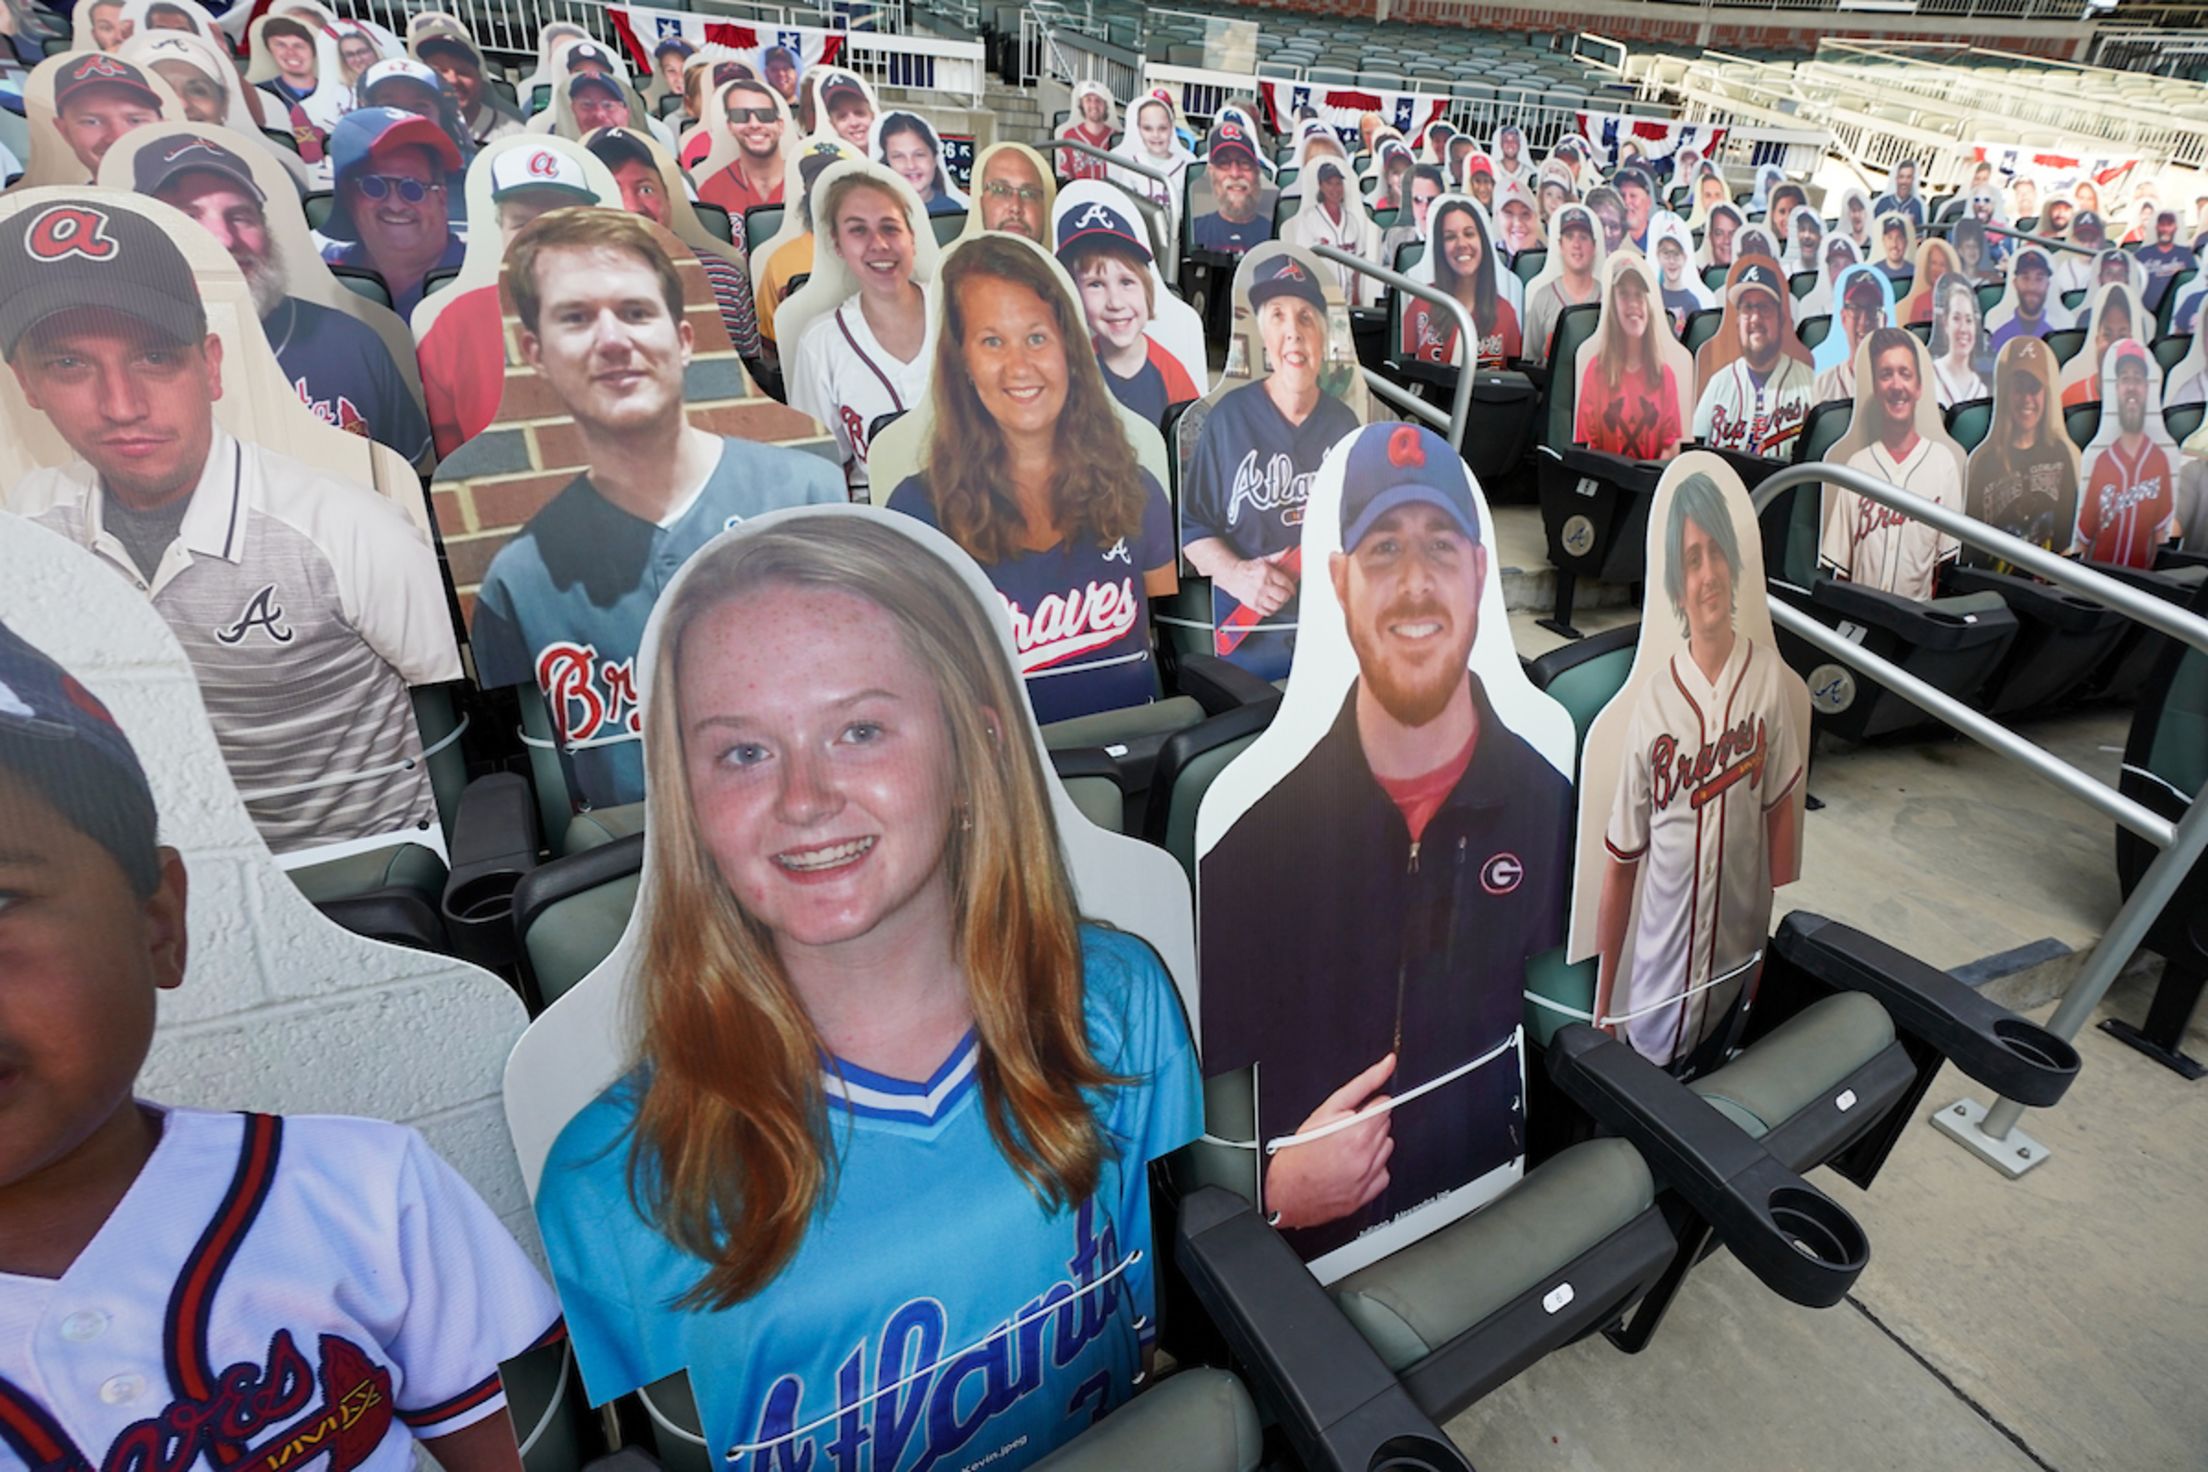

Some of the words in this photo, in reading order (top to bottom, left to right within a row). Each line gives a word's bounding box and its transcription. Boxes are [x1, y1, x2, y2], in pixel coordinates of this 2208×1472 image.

[1075, 203, 1114, 229] A
[1102, 536, 1131, 565] A
[214, 583, 296, 646] A
[998, 576, 1138, 651] raves
